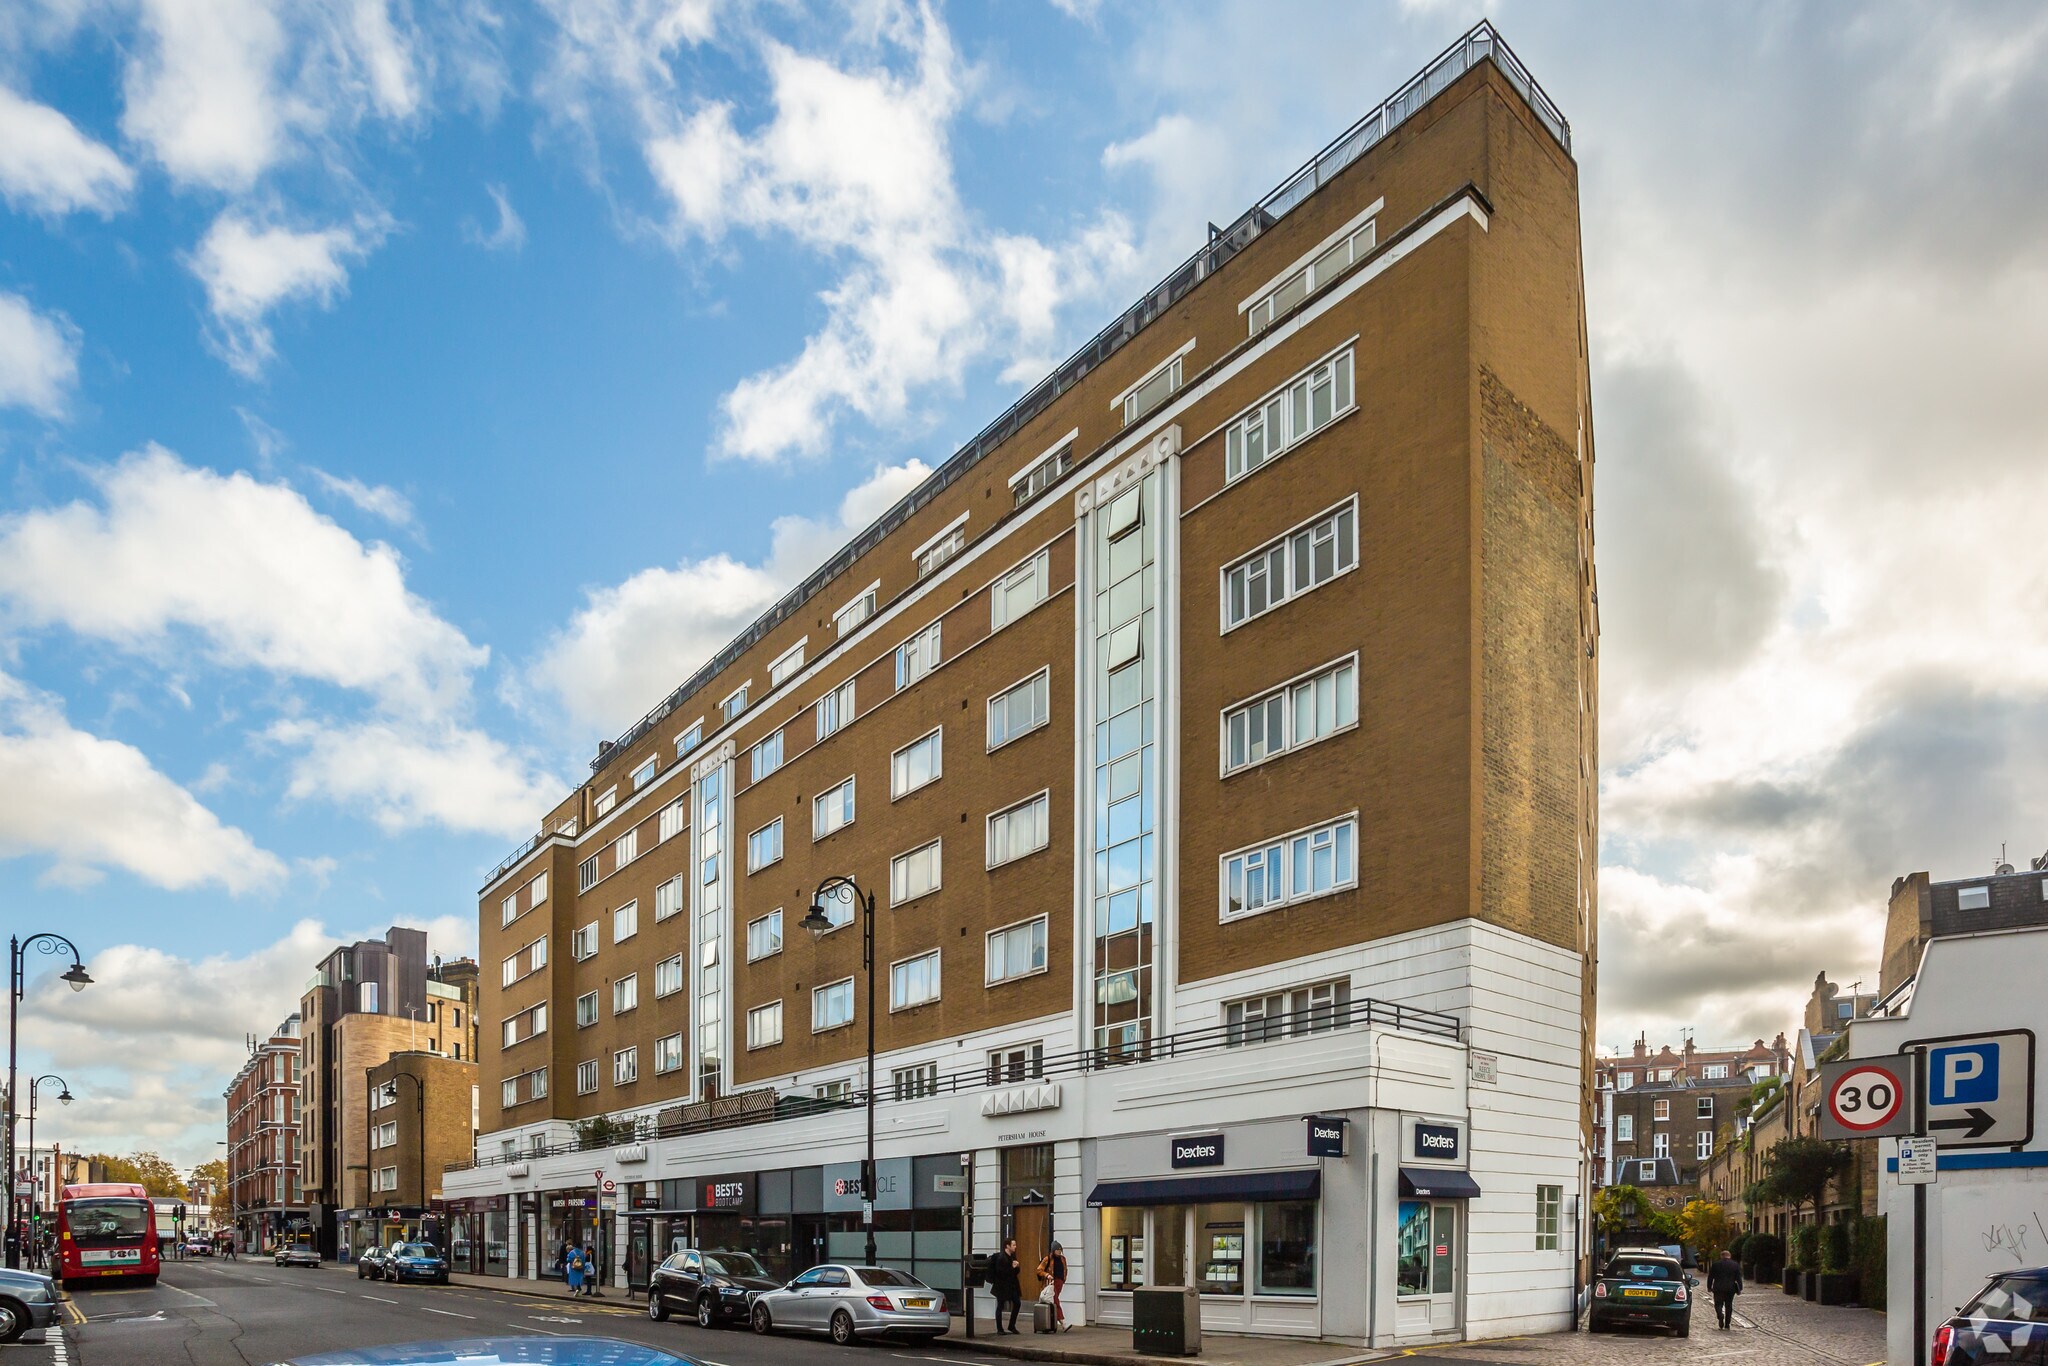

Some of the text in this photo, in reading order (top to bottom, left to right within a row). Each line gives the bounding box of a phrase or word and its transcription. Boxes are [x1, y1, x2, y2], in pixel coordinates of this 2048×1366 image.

[1944, 1052, 1984, 1098] P
[1839, 1084, 1892, 1113] 30
[998, 1130, 1047, 1142] PETERSHAM HOUSE
[1314, 1127, 1340, 1139] Dexters
[1422, 1133, 1455, 1149] Dexters
[1176, 1144, 1216, 1159] Dexters
[715, 1182, 743, 1197] BEST'S
[568, 1198, 586, 1206] PARSONS
[715, 1197, 744, 1207] BOOTCAMP
[101, 1221, 116, 1231] 70
